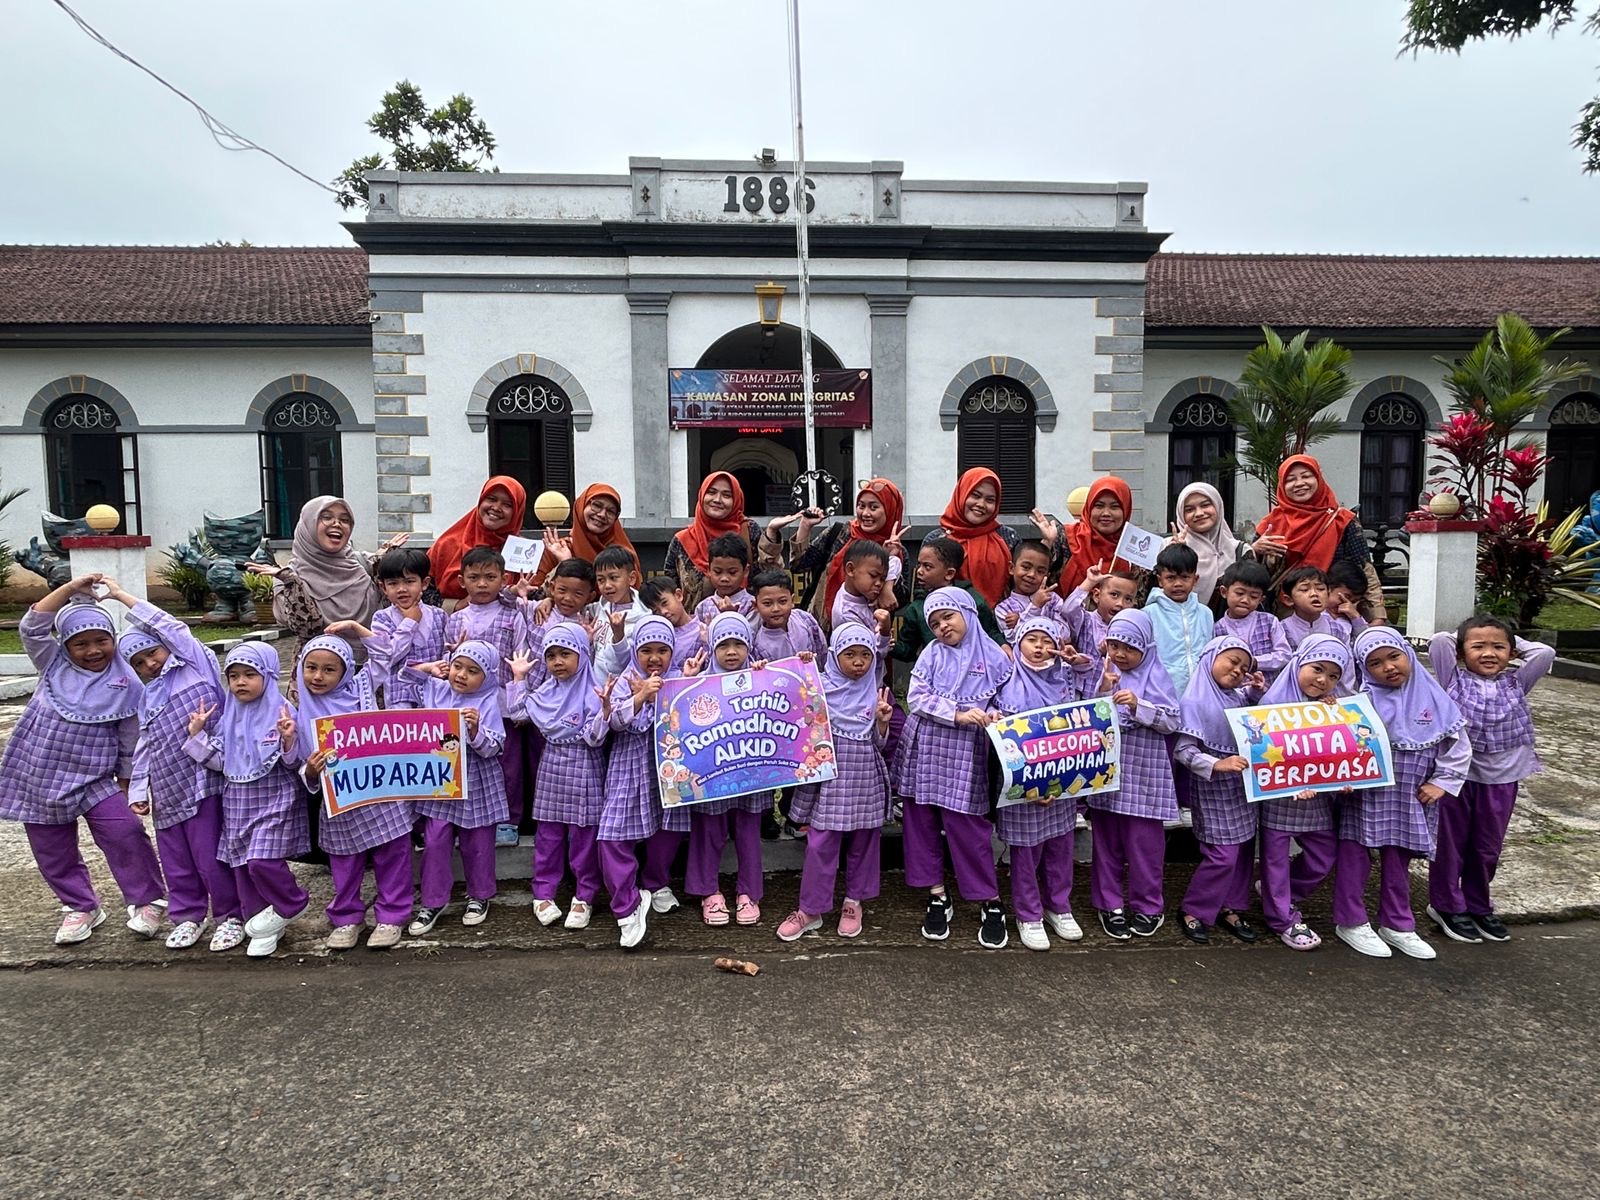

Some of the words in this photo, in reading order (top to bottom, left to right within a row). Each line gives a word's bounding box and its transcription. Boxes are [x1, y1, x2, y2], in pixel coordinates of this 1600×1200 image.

[722, 373, 773, 384] SELAMAT
[775, 373, 820, 384] DATAG
[687, 392, 747, 402] KAWASAN
[751, 392, 786, 402] ZONA
[729, 690, 791, 714] Tarhib
[1267, 703, 1345, 733] AYOK
[333, 722, 444, 750] RAMADHAN
[683, 712, 800, 755] Ramadhan
[1023, 730, 1100, 760] WELCOME
[1283, 729, 1347, 756] KITA
[714, 737, 777, 766] ALKID
[333, 761, 452, 797] MUBARAK
[1022, 750, 1105, 783] RAMADHAN
[1257, 756, 1380, 787] BERPUASA
